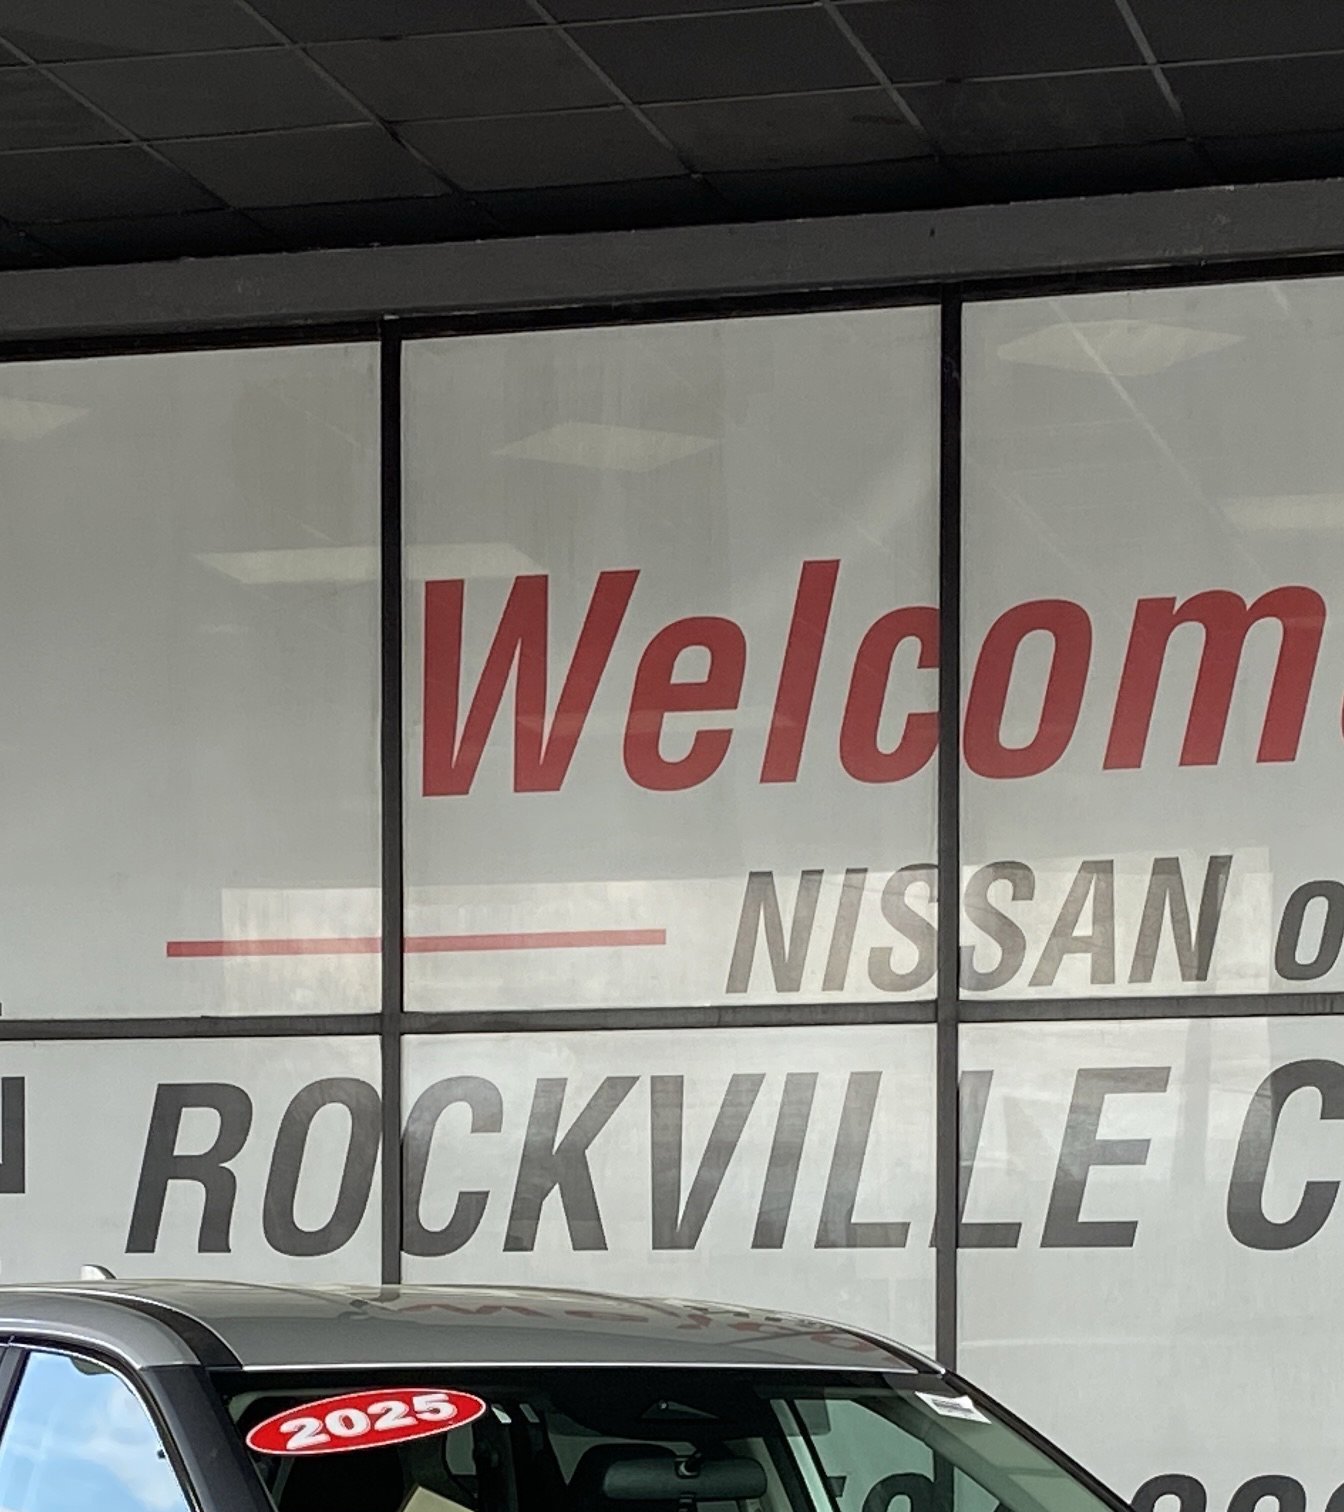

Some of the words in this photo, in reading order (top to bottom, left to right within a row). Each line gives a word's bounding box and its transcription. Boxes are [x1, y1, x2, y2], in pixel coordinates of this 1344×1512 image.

[726, 854, 1233, 992] NISSAN
[125, 1067, 1171, 1258] ROCKVILLE
[280, 1393, 458, 1450] 2025
